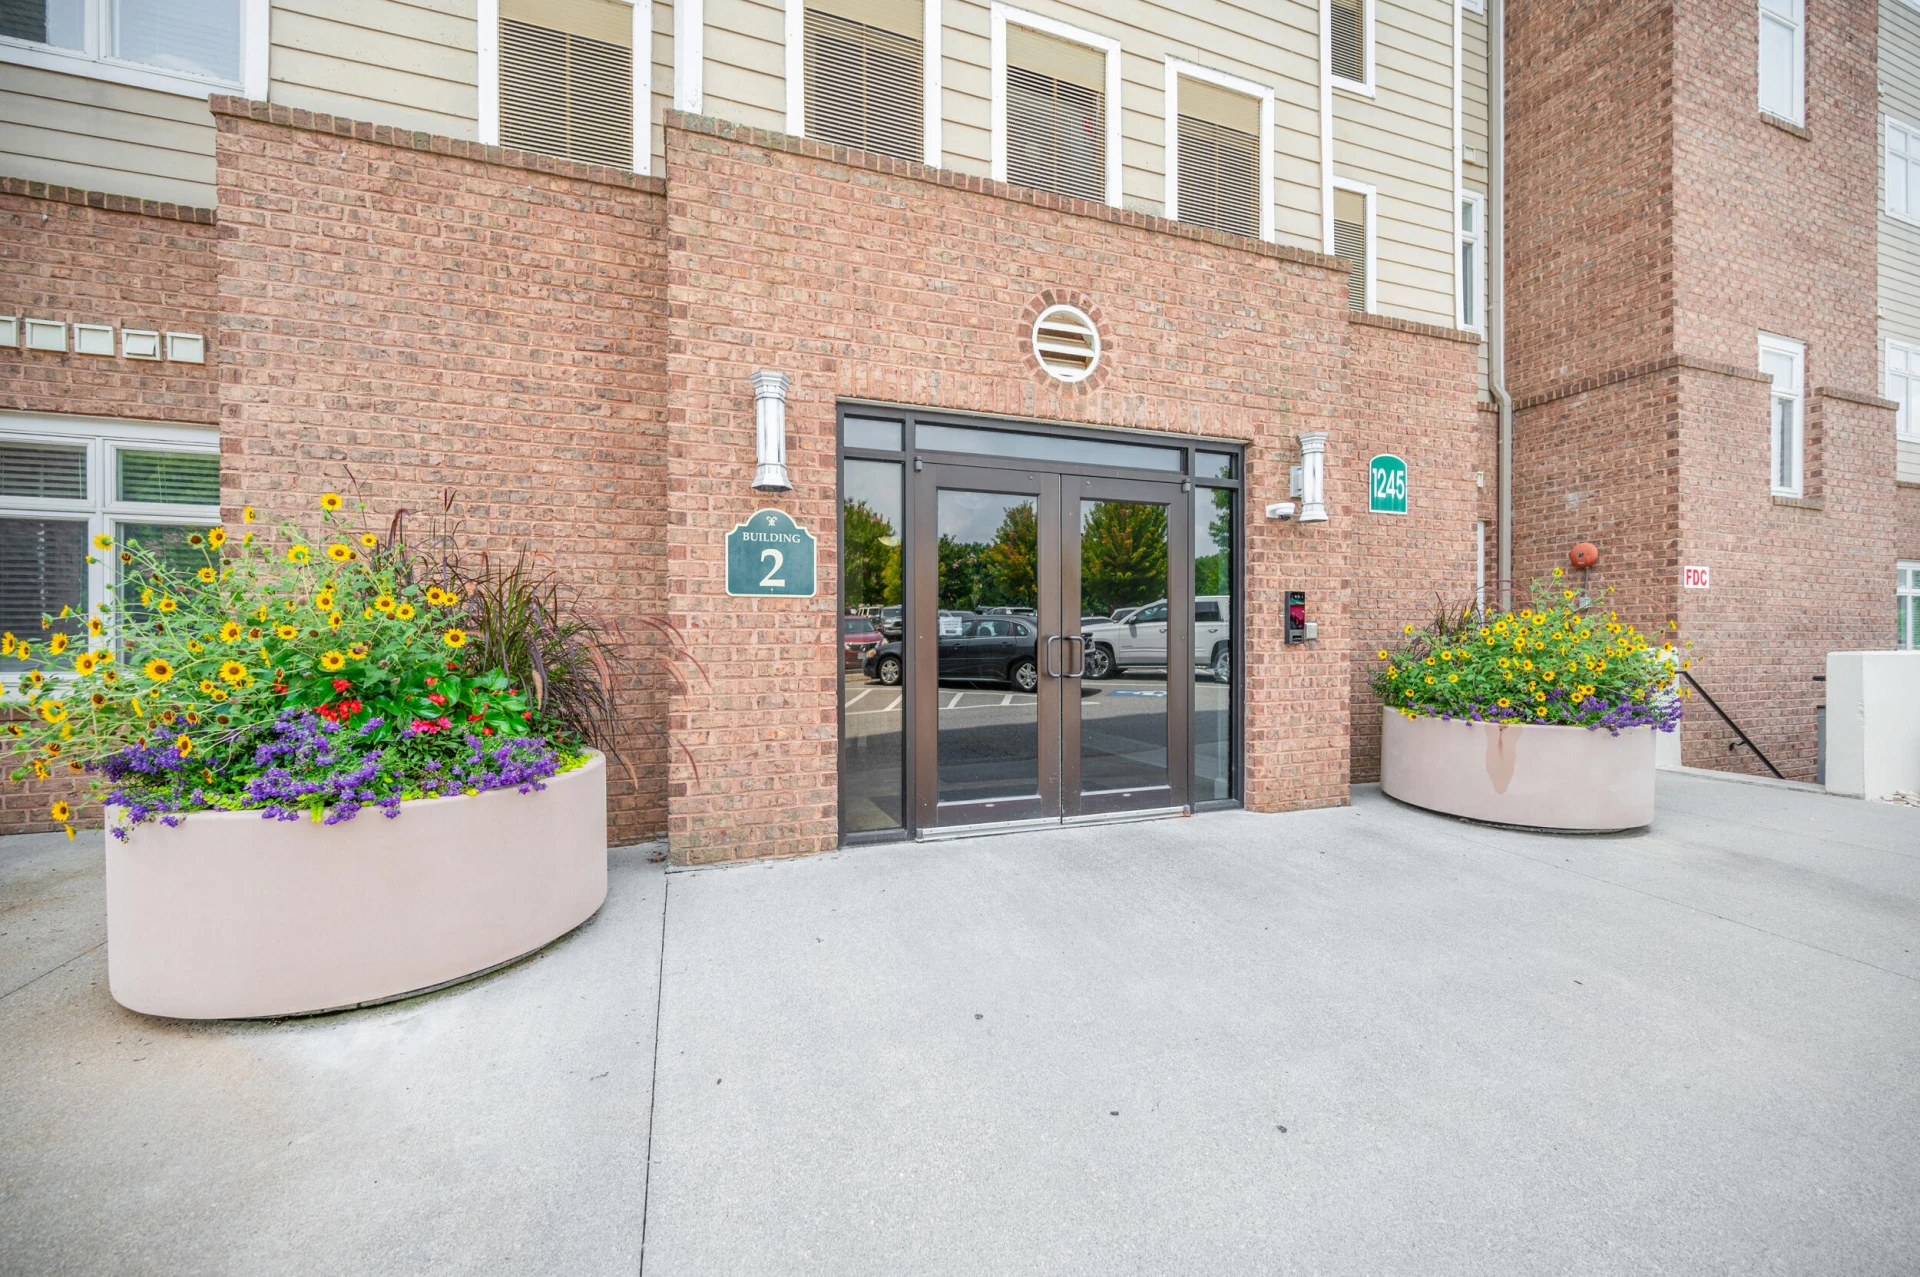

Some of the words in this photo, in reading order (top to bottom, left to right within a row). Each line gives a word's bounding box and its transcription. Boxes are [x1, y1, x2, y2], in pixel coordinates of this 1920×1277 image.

[1372, 467, 1405, 500] 1245
[742, 531, 801, 544] BUILDING
[759, 548, 786, 587] 2
[1686, 569, 1707, 586] FDC
